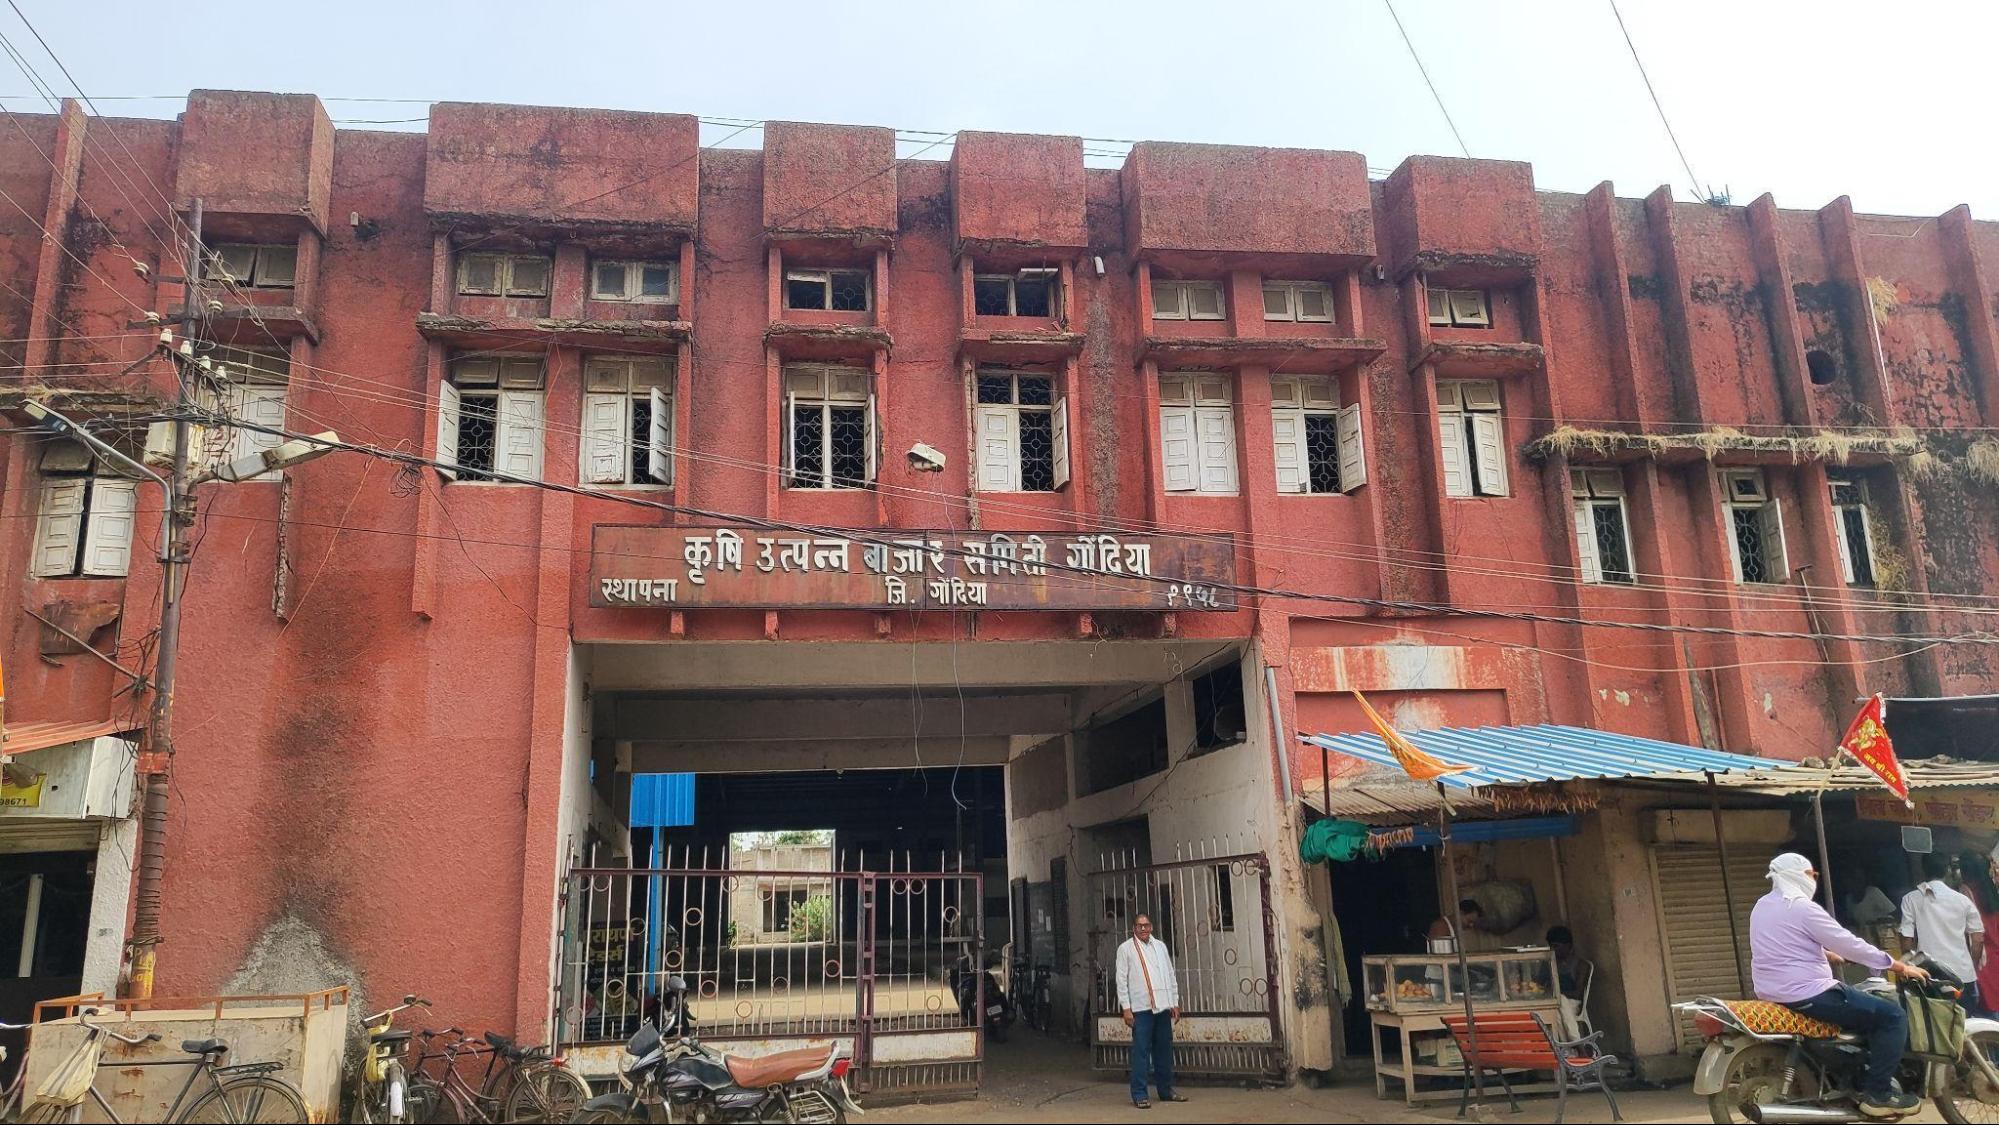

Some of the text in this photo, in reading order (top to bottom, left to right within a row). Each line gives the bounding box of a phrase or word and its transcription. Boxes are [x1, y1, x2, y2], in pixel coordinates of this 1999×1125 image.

[684, 529, 744, 585] कृषि
[756, 537, 850, 572] उत्पन्न
[863, 539, 945, 574] बाजार
[962, 533, 1047, 576] समिती
[601, 577, 679, 602] स्थापना
[929, 576, 988, 605] गोंदिया
